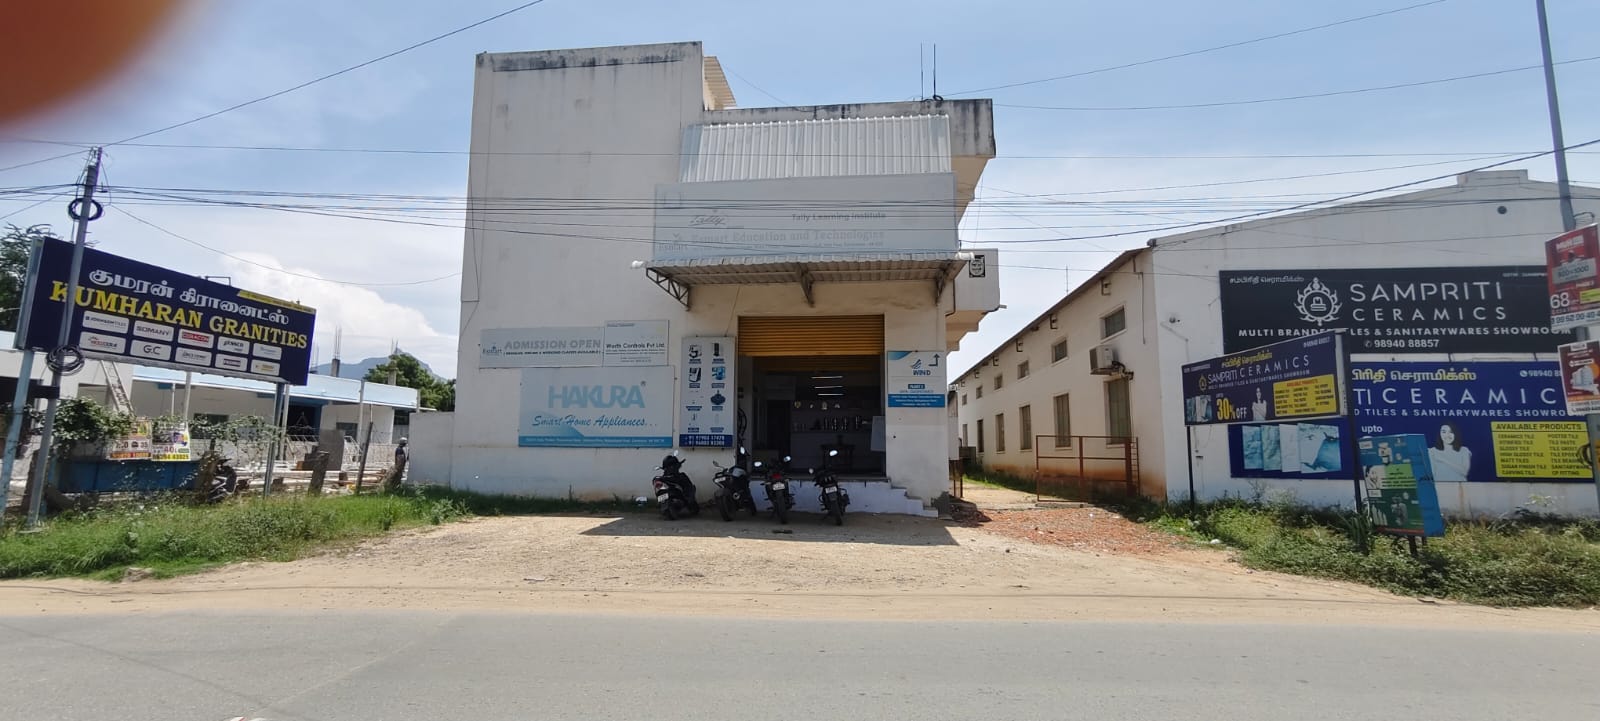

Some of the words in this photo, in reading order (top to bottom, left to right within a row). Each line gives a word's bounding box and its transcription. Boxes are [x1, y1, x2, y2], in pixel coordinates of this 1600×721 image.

[792, 213, 809, 222] Tally
[813, 212, 849, 222] Learning
[733, 231, 787, 242] Education
[790, 230, 809, 241] and
[814, 229, 885, 242] Technologies
[89, 269, 175, 298] குமரன்
[1350, 282, 1502, 302] SAMPRITI
[1550, 292, 1570, 308] 68
[50, 280, 204, 329] KUMHARAN
[209, 315, 308, 349] GRANITIES
[1352, 307, 1506, 321] CERAMICS
[1238, 329, 1274, 337] MULTI
[1278, 328, 1332, 337] BRAND
[1374, 328, 1382, 336] &
[1386, 327, 1490, 336] SANITARYWARES
[504, 340, 567, 350] ADMISSION
[569, 339, 602, 349] OPEN
[1374, 339, 1405, 348] 98940
[1408, 339, 1440, 348] 88857
[1207, 370, 1238, 384] SAMPRITI
[1240, 354, 1309, 377] CERAMICS
[1390, 367, 1477, 383] செராமிக்ஸ்
[1529, 369, 1553, 377] 98940
[548, 385, 646, 409] HAKURA
[1382, 387, 1557, 405] CERAMIC
[1216, 397, 1236, 421] 30%
[1236, 407, 1247, 419] OFF
[1364, 408, 1397, 416] TILES
[1401, 408, 1408, 416] &
[1413, 408, 1511, 417] SANITARYWARES
[1515, 409, 1565, 417] SHOWRO
[531, 415, 563, 427] Smart
[564, 414, 592, 426] Home
[1361, 424, 1383, 434] upto
